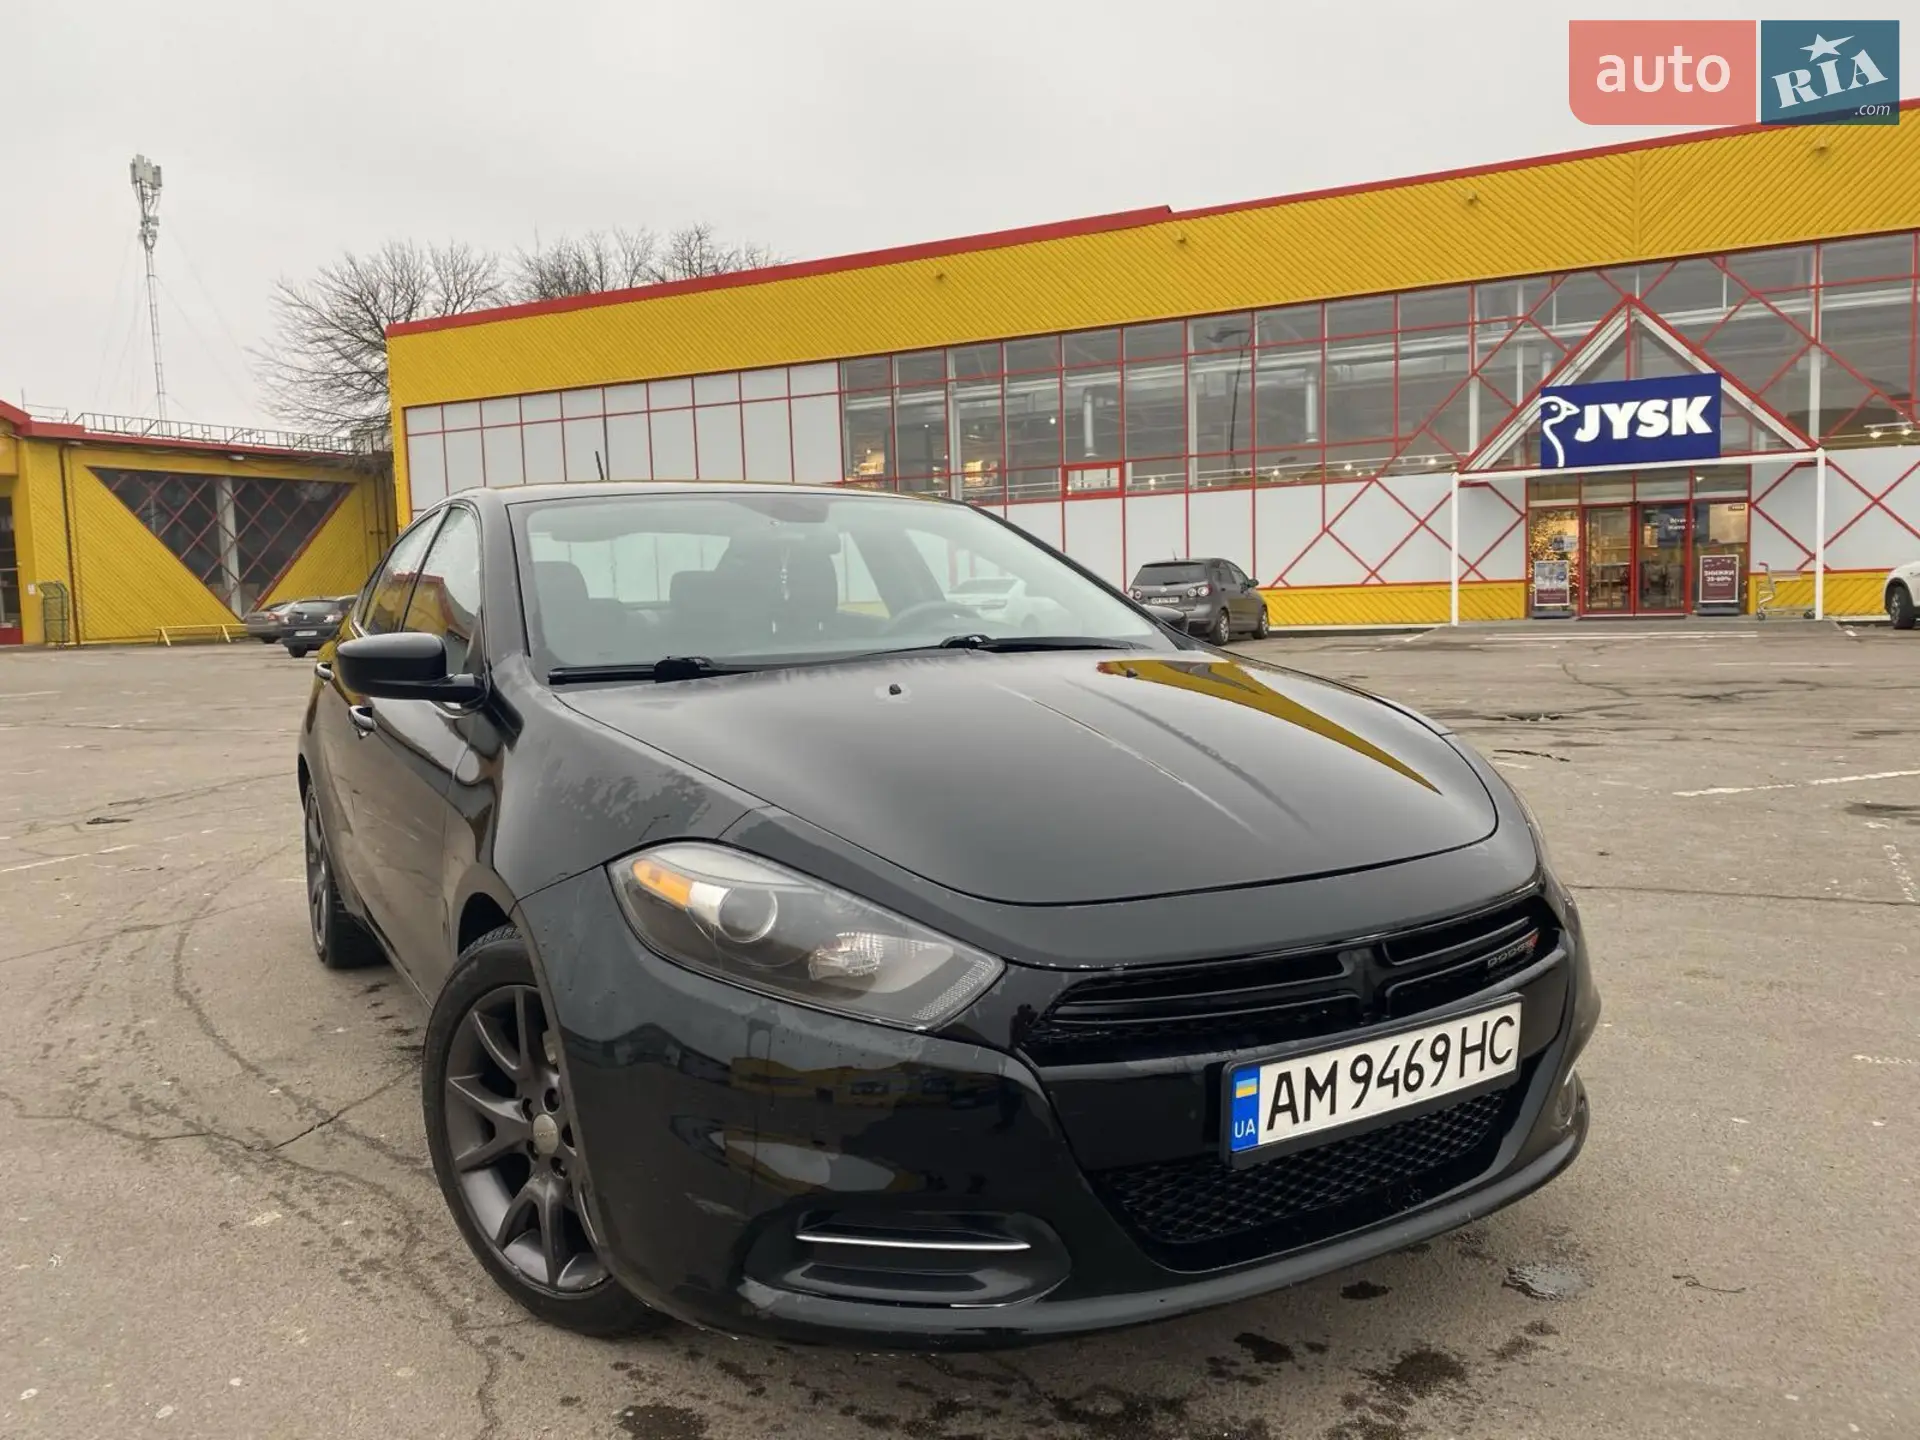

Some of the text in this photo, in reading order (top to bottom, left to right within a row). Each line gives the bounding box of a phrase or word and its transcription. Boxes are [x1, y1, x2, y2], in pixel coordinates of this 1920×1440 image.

[1574, 395, 1713, 442] JYSK
[1266, 1015, 1515, 1131] AM 9469 HC
[1234, 1122, 1256, 1139] UA
